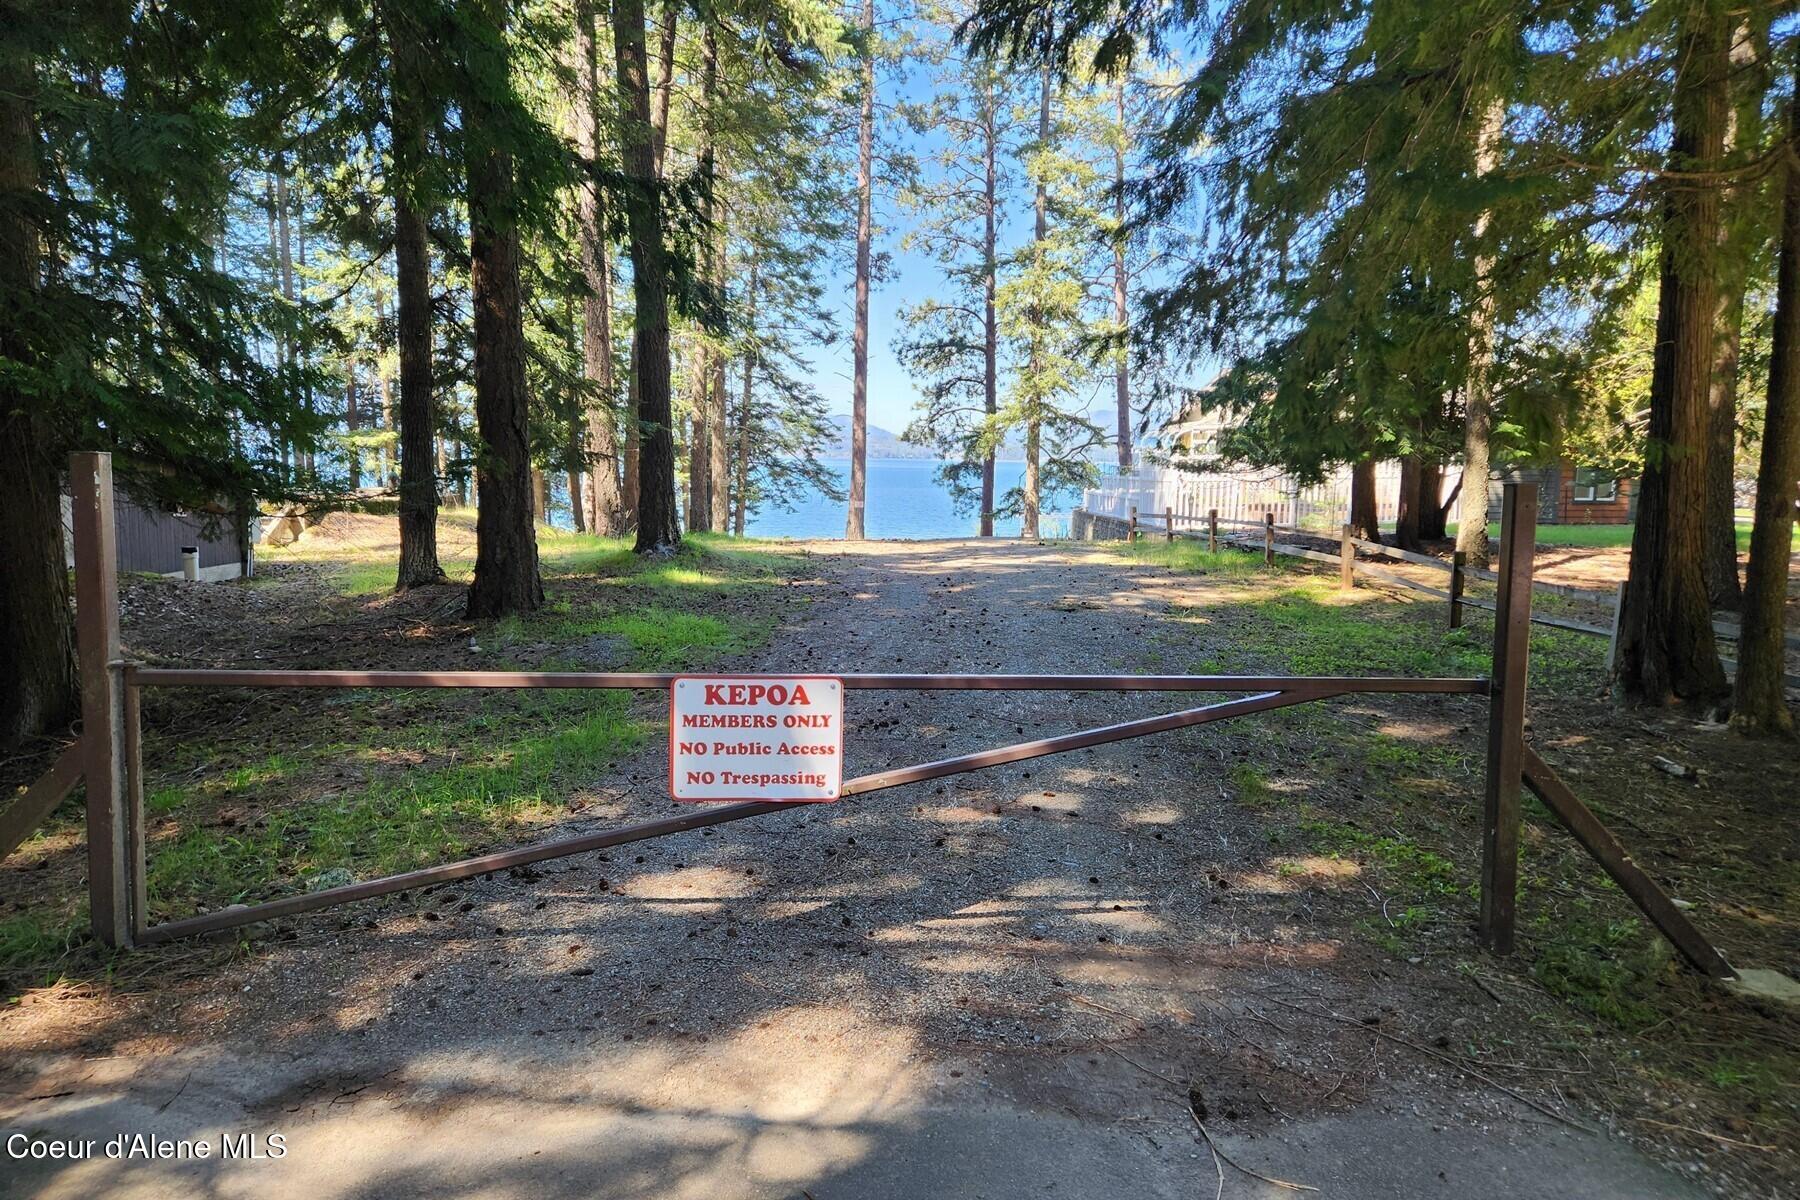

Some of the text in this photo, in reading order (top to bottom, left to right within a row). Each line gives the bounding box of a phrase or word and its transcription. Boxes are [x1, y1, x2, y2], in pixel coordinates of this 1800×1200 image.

[704, 684, 811, 706] KEPOA
[682, 714, 832, 728] MEMBERS ONLY
[680, 742, 835, 755] NO Public Access
[687, 771, 826, 787] NO Trespassing
